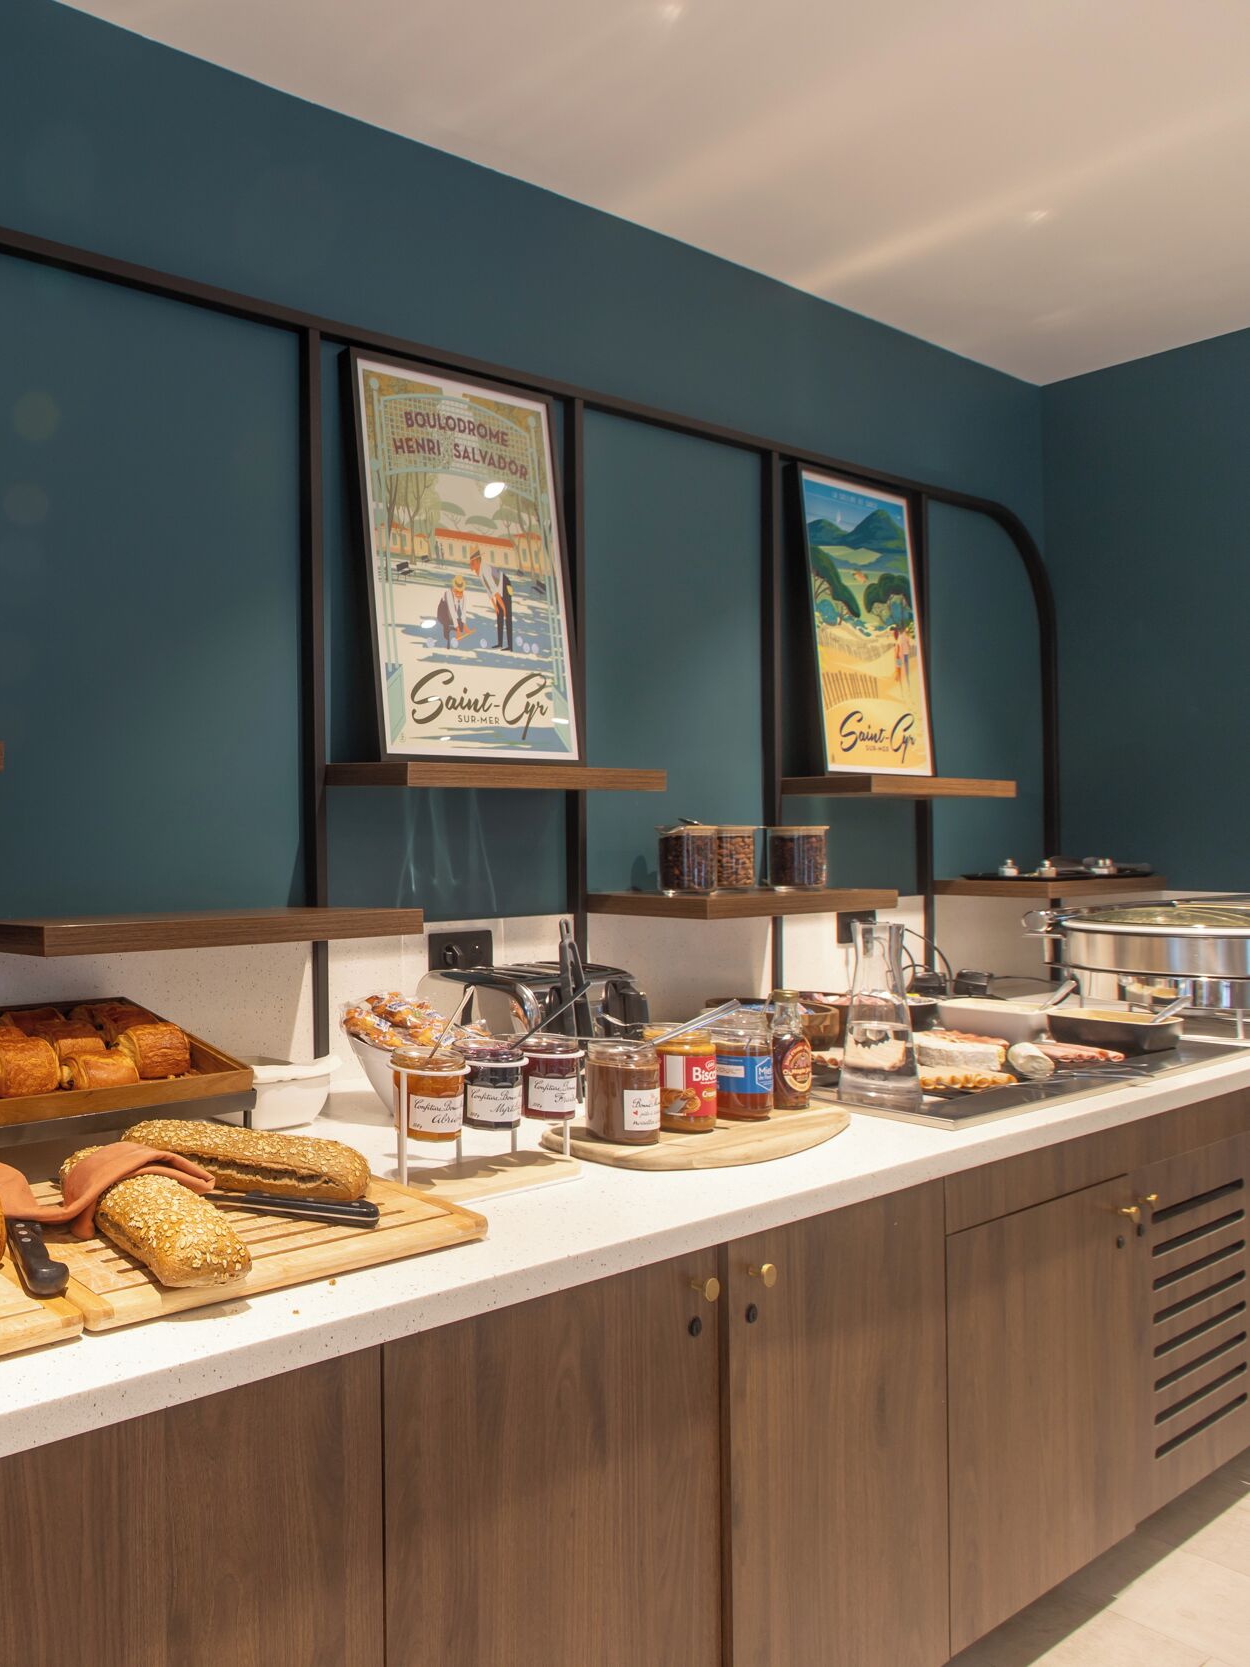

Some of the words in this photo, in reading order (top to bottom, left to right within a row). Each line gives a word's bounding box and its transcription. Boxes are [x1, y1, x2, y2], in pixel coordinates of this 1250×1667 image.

[403, 410, 510, 448] BOULODROME
[392, 436, 442, 457] HENRI
[452, 442, 529, 481] SALVADOR
[410, 668, 549, 741] Saint-Cyr
[457, 714, 500, 725] SUR-MER
[839, 710, 917, 764] Saint-Cyr
[413, 1097, 442, 1112] Confiture
